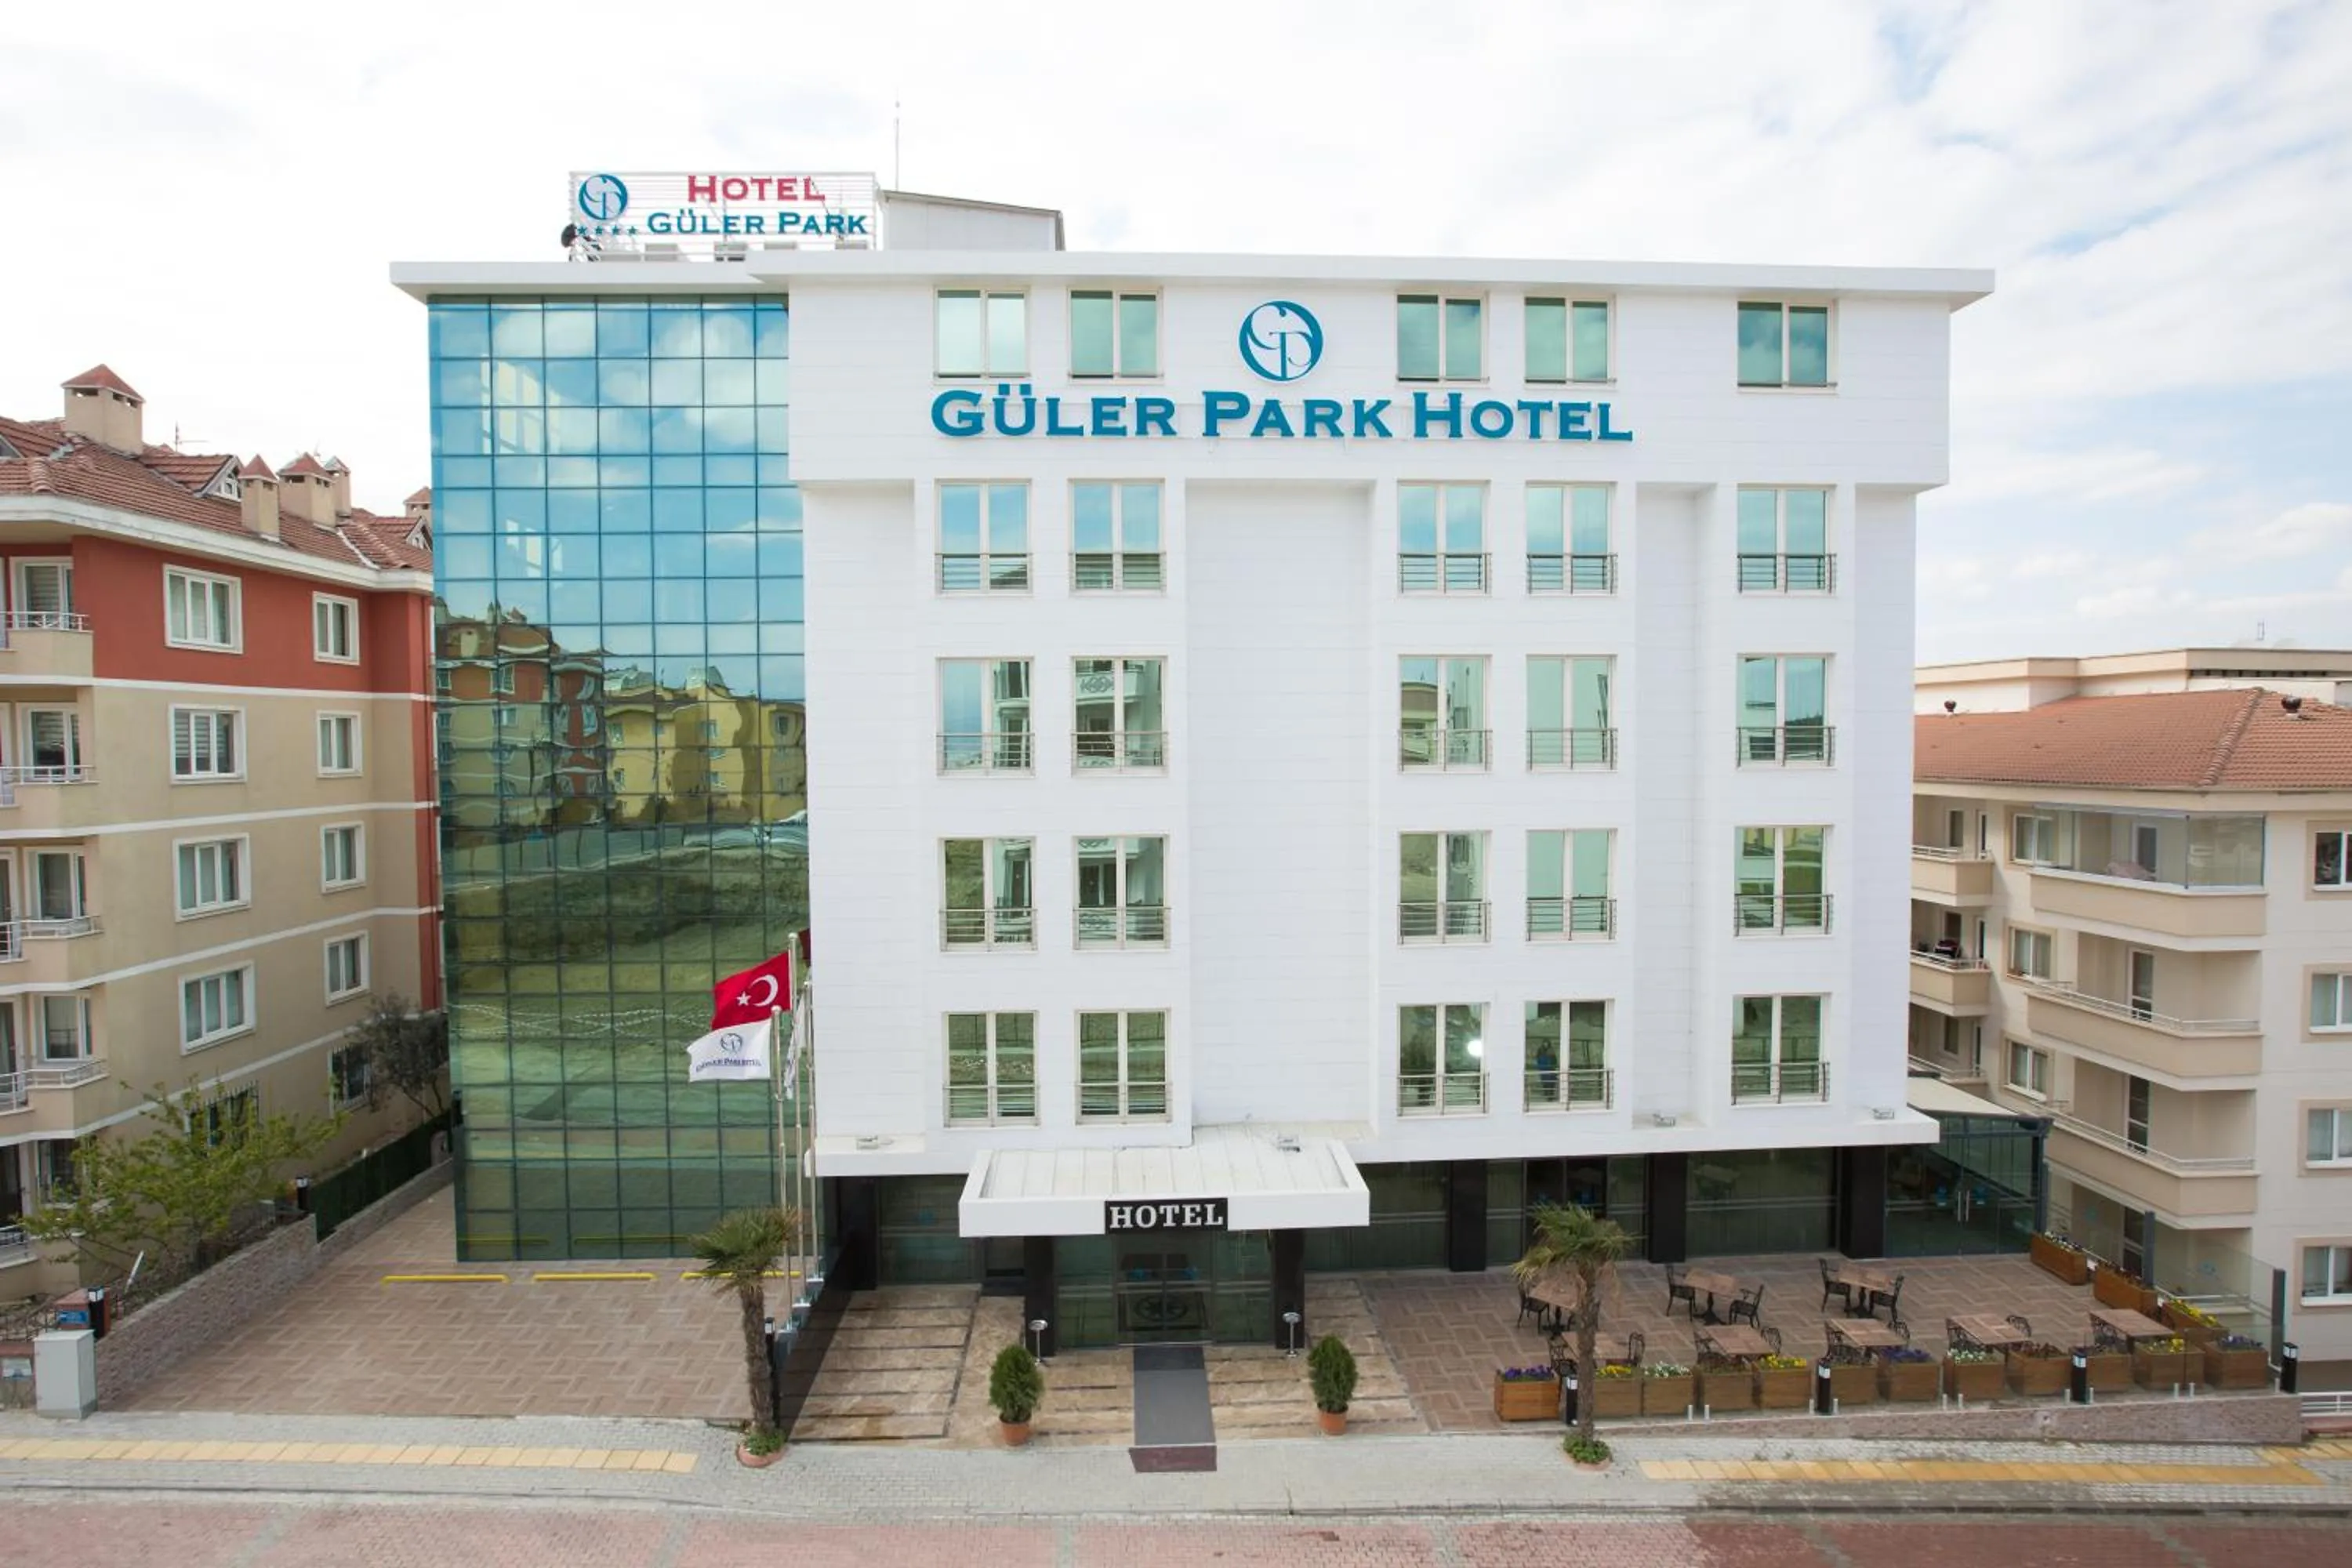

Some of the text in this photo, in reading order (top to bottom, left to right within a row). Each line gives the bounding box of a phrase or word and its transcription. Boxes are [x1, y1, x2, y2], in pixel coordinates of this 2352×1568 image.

[688, 175, 826, 202] HOTEL
[648, 209, 868, 235] GÜLER PARK
[931, 383, 1633, 442] GÜLER PARK HOTEL
[1109, 1203, 1225, 1229] HOTEL
